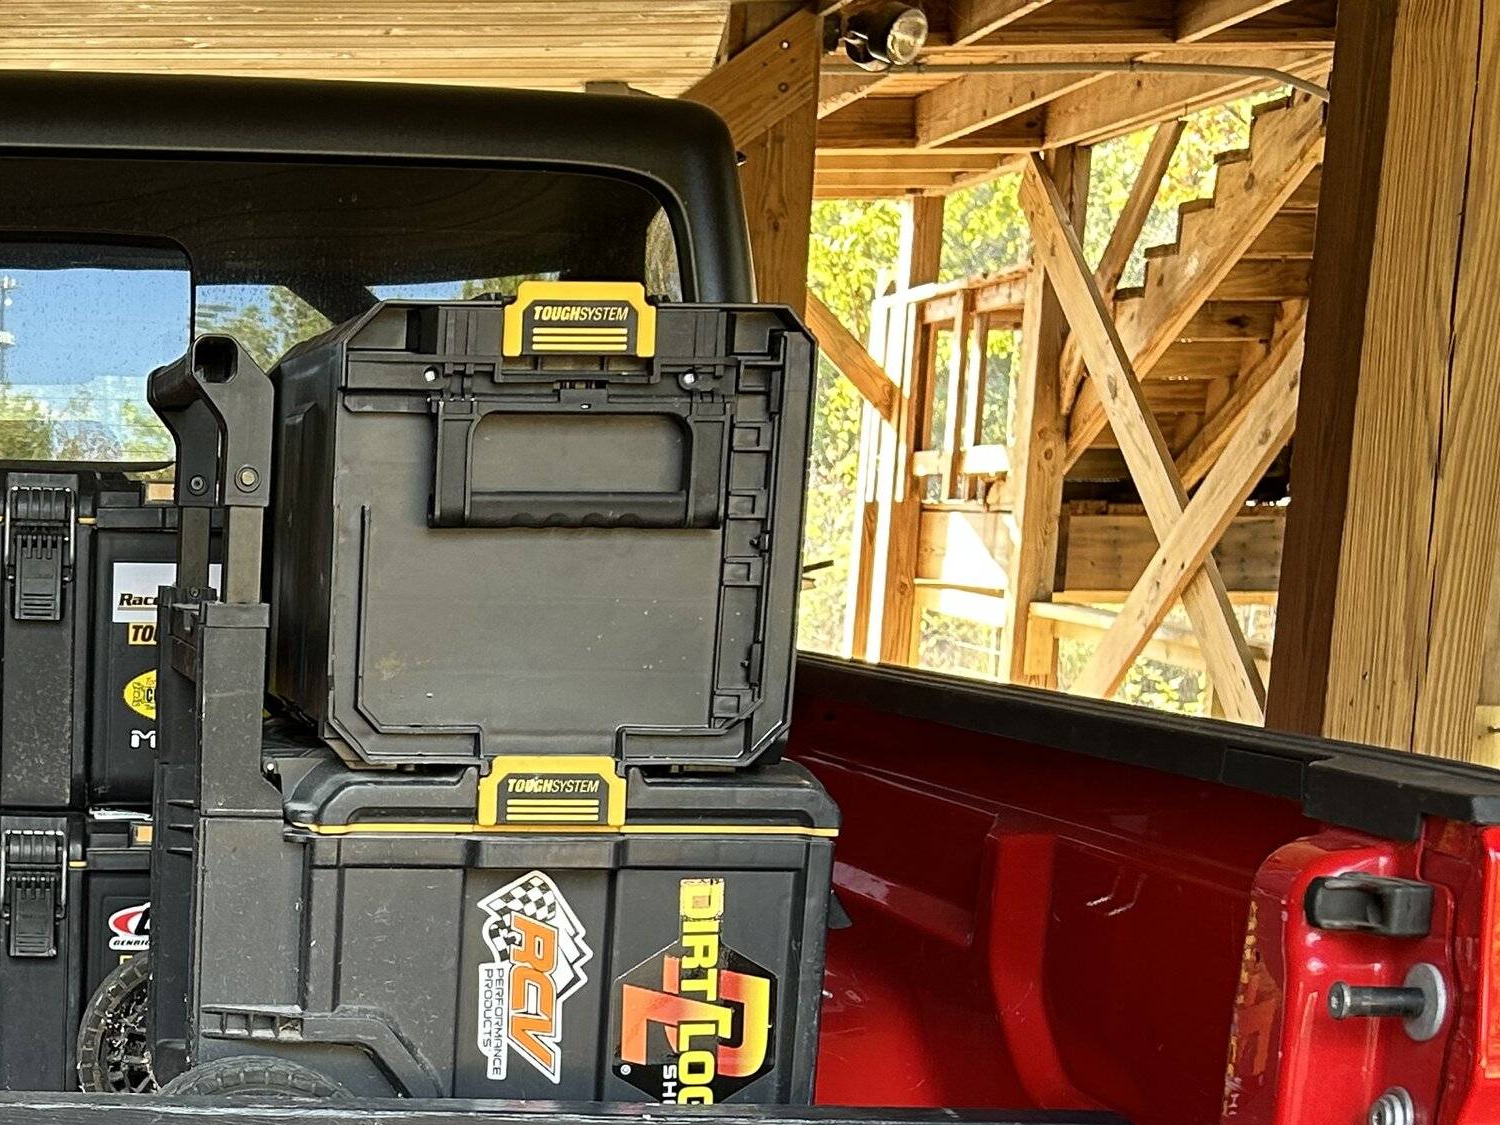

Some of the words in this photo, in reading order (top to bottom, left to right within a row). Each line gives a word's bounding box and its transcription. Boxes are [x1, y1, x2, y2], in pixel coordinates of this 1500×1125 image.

[533, 305, 629, 321] TOUGHSYSTEM
[132, 625, 157, 642] TO
[507, 778, 599, 793] TOUGHSYSTEM
[680, 880, 723, 1001] DIRT
[482, 967, 494, 1048] PRODUCTS
[492, 967, 505, 1077] PERFORMANCE
[509, 911, 558, 1074] RCV
[662, 1064, 677, 1105] SH
